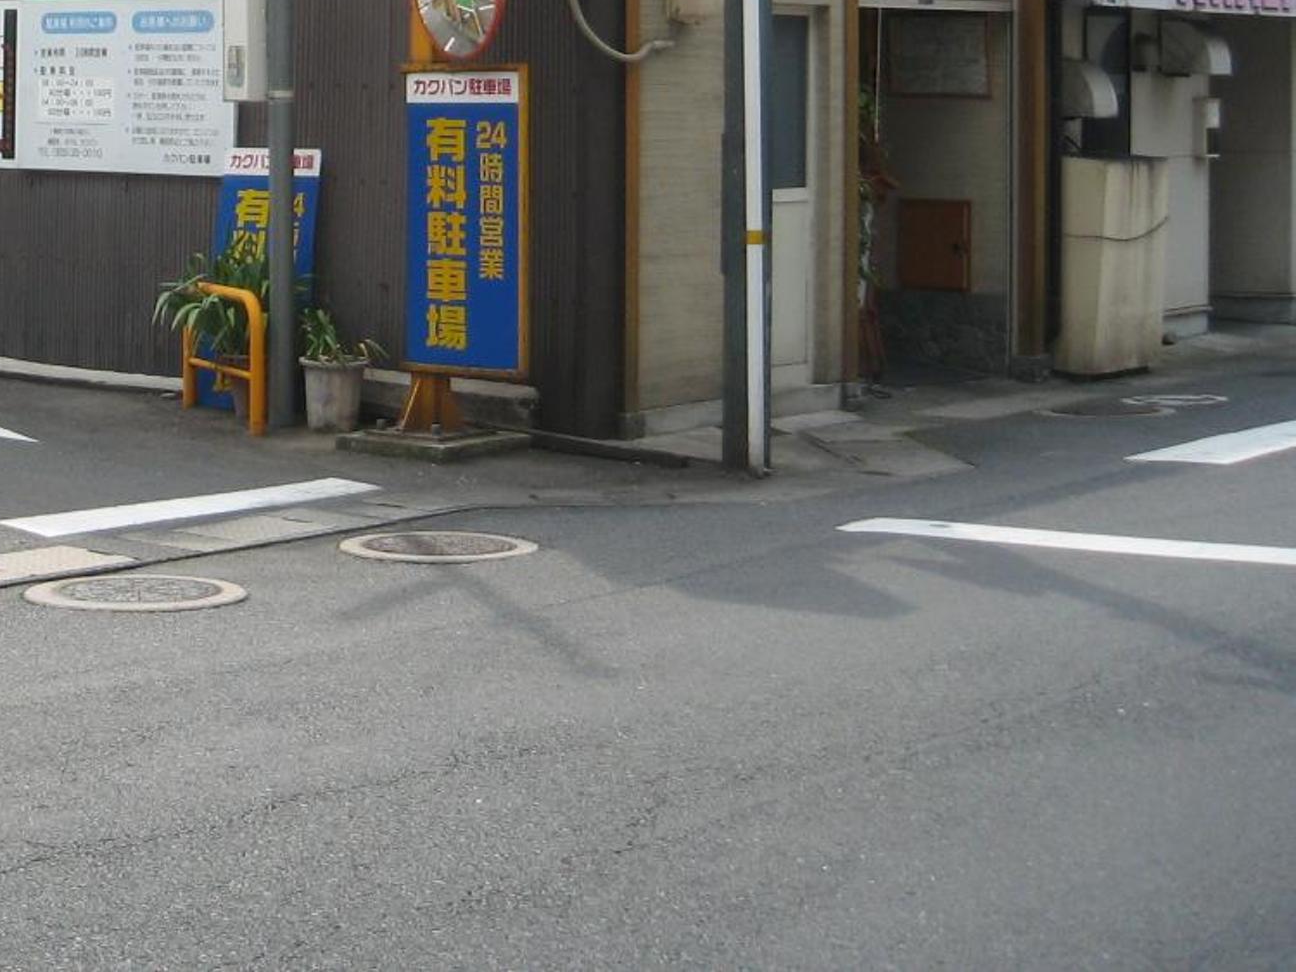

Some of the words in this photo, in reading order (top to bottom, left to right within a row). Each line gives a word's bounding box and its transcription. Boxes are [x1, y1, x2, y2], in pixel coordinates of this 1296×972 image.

[413, 77, 512, 96] カクバン駐車場
[425, 117, 468, 350] 有料駐車場
